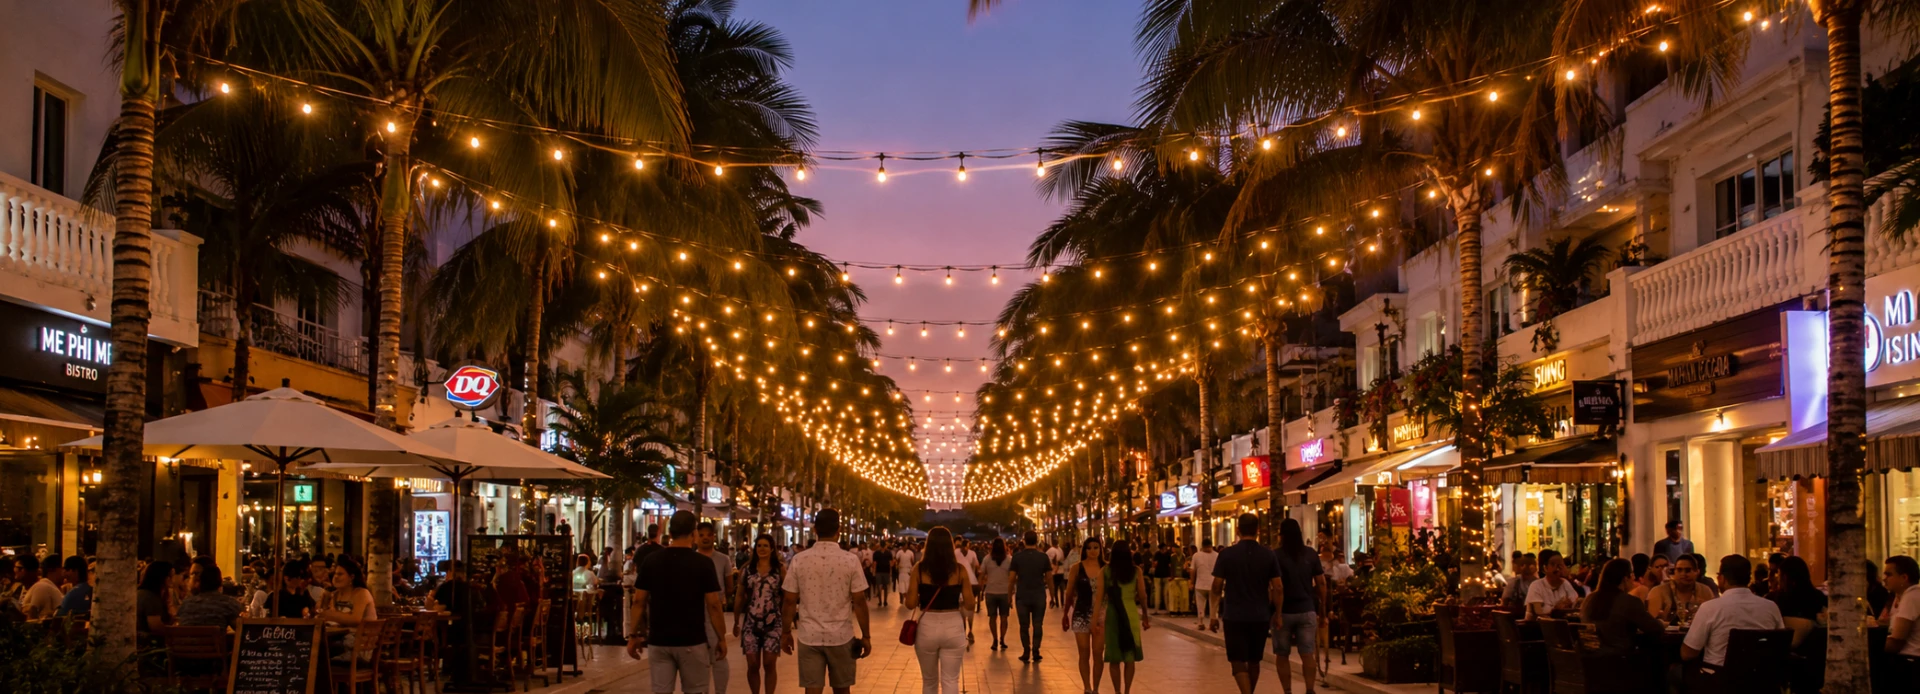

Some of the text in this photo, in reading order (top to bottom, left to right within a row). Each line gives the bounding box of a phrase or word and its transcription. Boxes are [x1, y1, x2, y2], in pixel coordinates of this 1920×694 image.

[42, 326, 65, 355] ME
[67, 333, 92, 361] PHI
[66, 362, 98, 381] BISTRO
[453, 375, 491, 396] DQ
